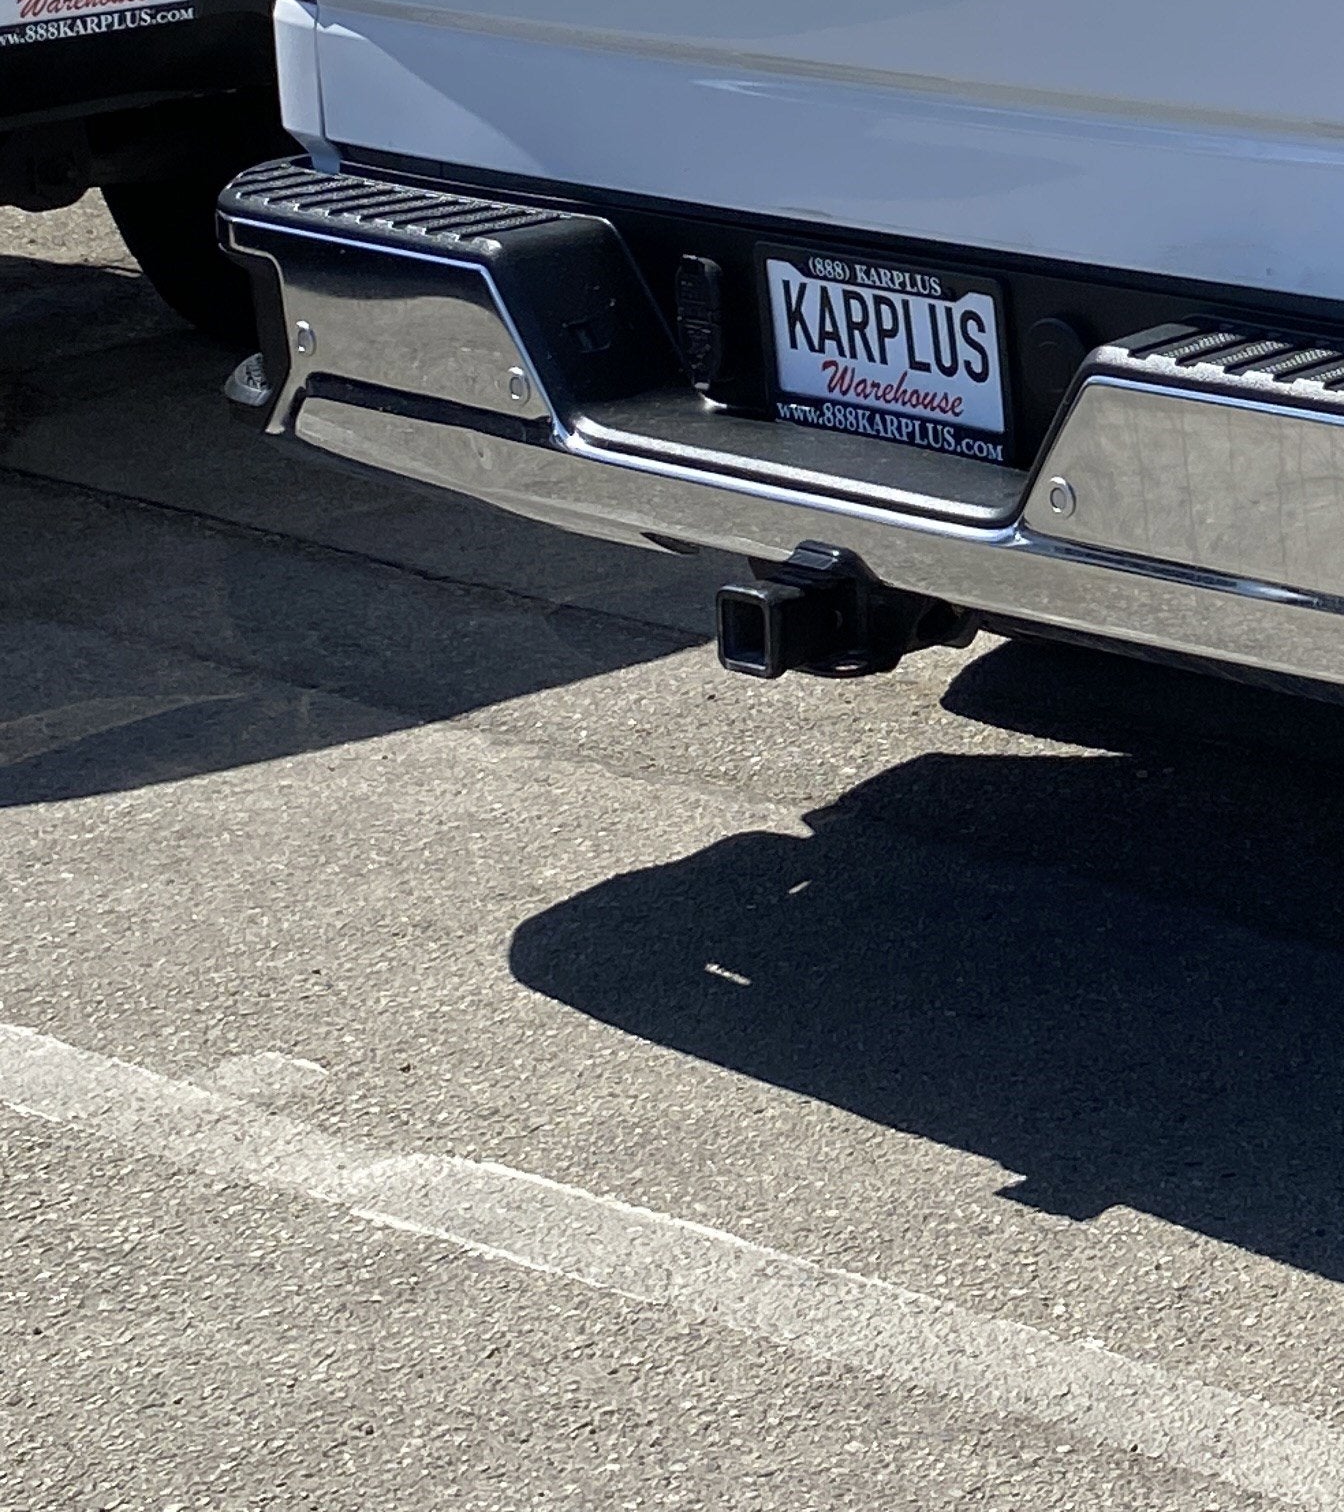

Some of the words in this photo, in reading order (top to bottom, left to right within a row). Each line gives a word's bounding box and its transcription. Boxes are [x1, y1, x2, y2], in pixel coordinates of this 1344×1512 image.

[808, 256, 851, 281] (888)
[855, 264, 942, 297] KARPLUS
[782, 279, 990, 384] KARPLUS
[821, 359, 965, 418] Warehouse
